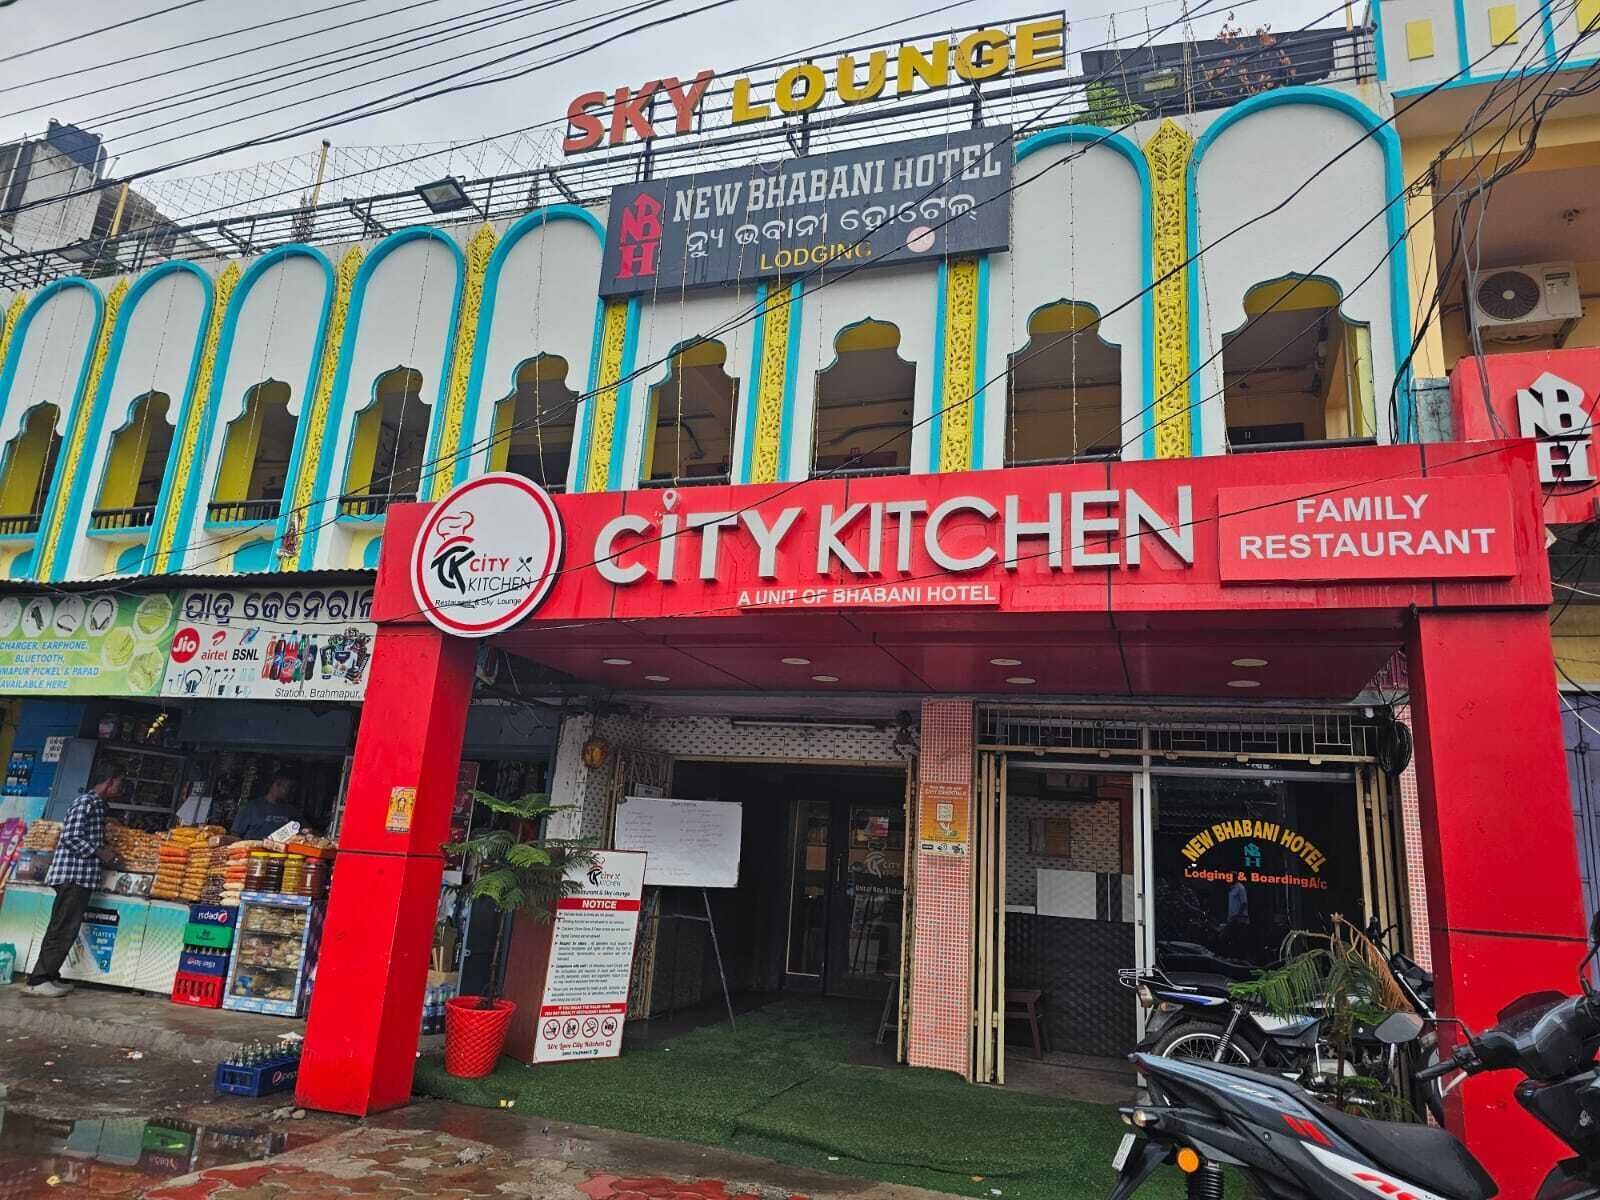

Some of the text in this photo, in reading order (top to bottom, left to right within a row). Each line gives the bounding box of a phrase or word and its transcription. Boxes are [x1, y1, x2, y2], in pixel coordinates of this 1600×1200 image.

[563, 18, 1065, 155] SKY LOUNGE
[672, 142, 1001, 223] NEW BHABANI HOTEL
[760, 241, 872, 271] LODGING
[1296, 493, 1429, 524] FAMILY
[594, 484, 1194, 586] CITY KITCHEN
[1240, 528, 1496, 560] RESTAURANT
[469, 554, 510, 572] CITY
[467, 576, 532, 592] KITCHEN
[497, 598, 522, 607] Lounge
[737, 584, 995, 606] A UNIT OF BHABANI HOTEL
[173, 638, 197, 653] Jio
[201, 650, 228, 661] airtel
[232, 649, 260, 661] BSNL
[72, 667, 100, 676] PAPAD
[0, 680, 69, 689] AVAILABLE HERE
[1181, 819, 1328, 873] NEW BHABANI HOTEL
[1184, 868, 1233, 883] Lodging
[1237, 871, 1247, 882] &
[582, 900, 618, 909] NOTICE
